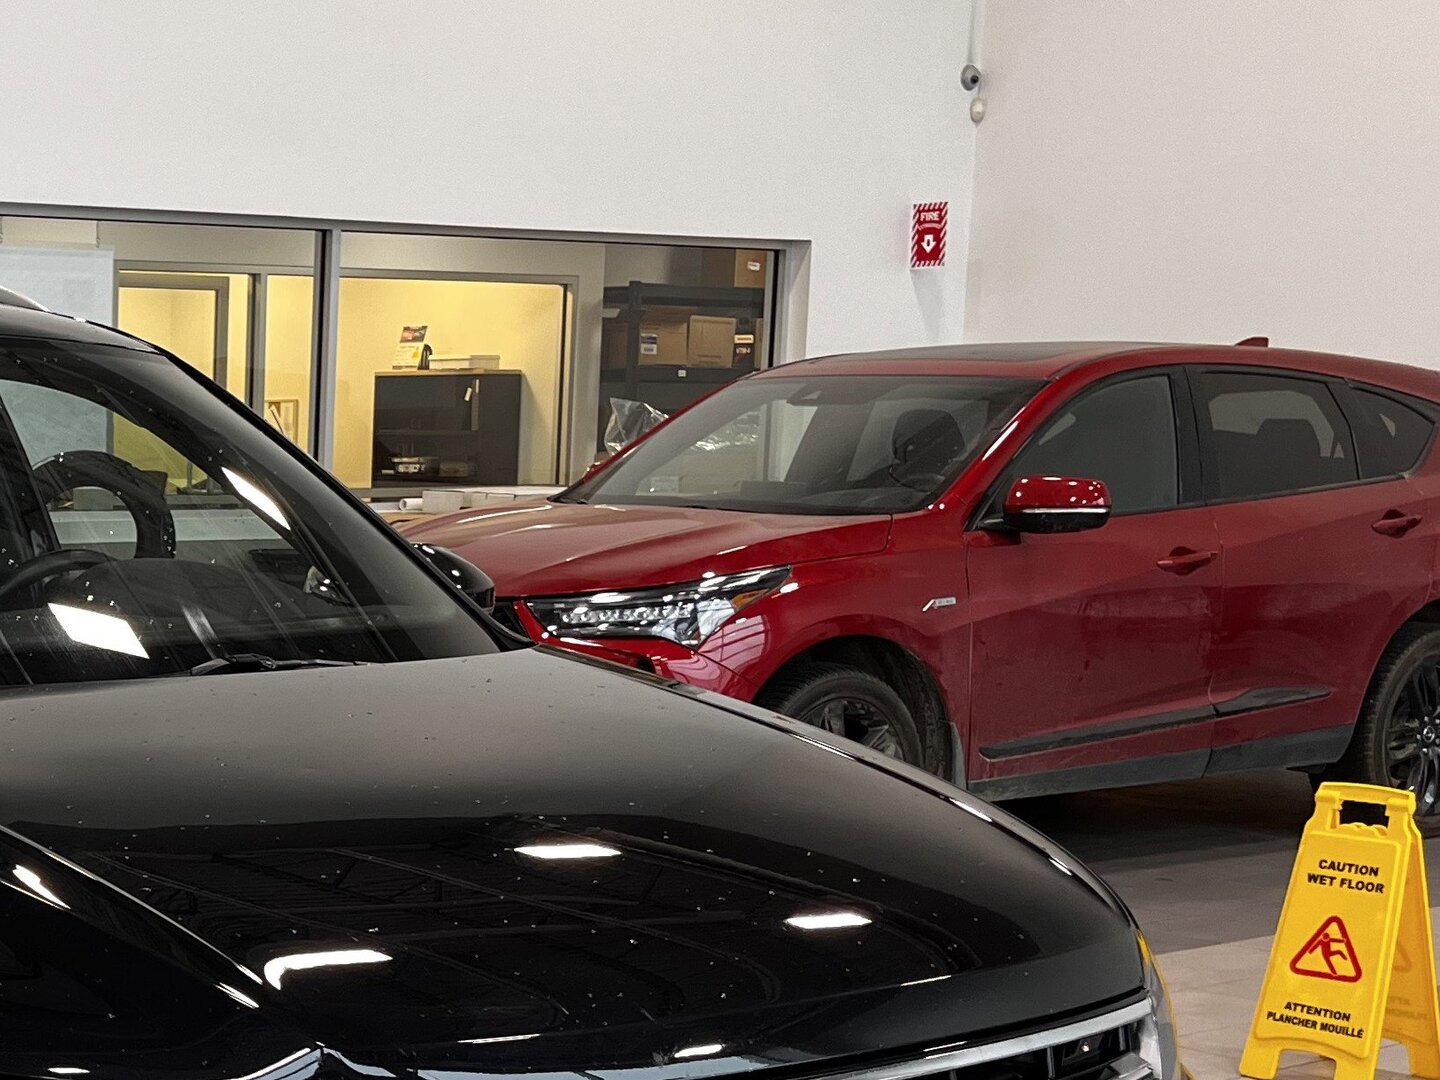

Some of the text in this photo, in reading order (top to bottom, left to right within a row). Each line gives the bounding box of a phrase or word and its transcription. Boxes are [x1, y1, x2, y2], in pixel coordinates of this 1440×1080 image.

[919, 210, 941, 222] FIRE
[1318, 859, 1380, 877] CAUTION
[1306, 872, 1385, 894] WET FLOOR
[1284, 1001, 1351, 1022] ATTENTION
[1266, 1010, 1365, 1039] PLANCHER MOUILLÉ
